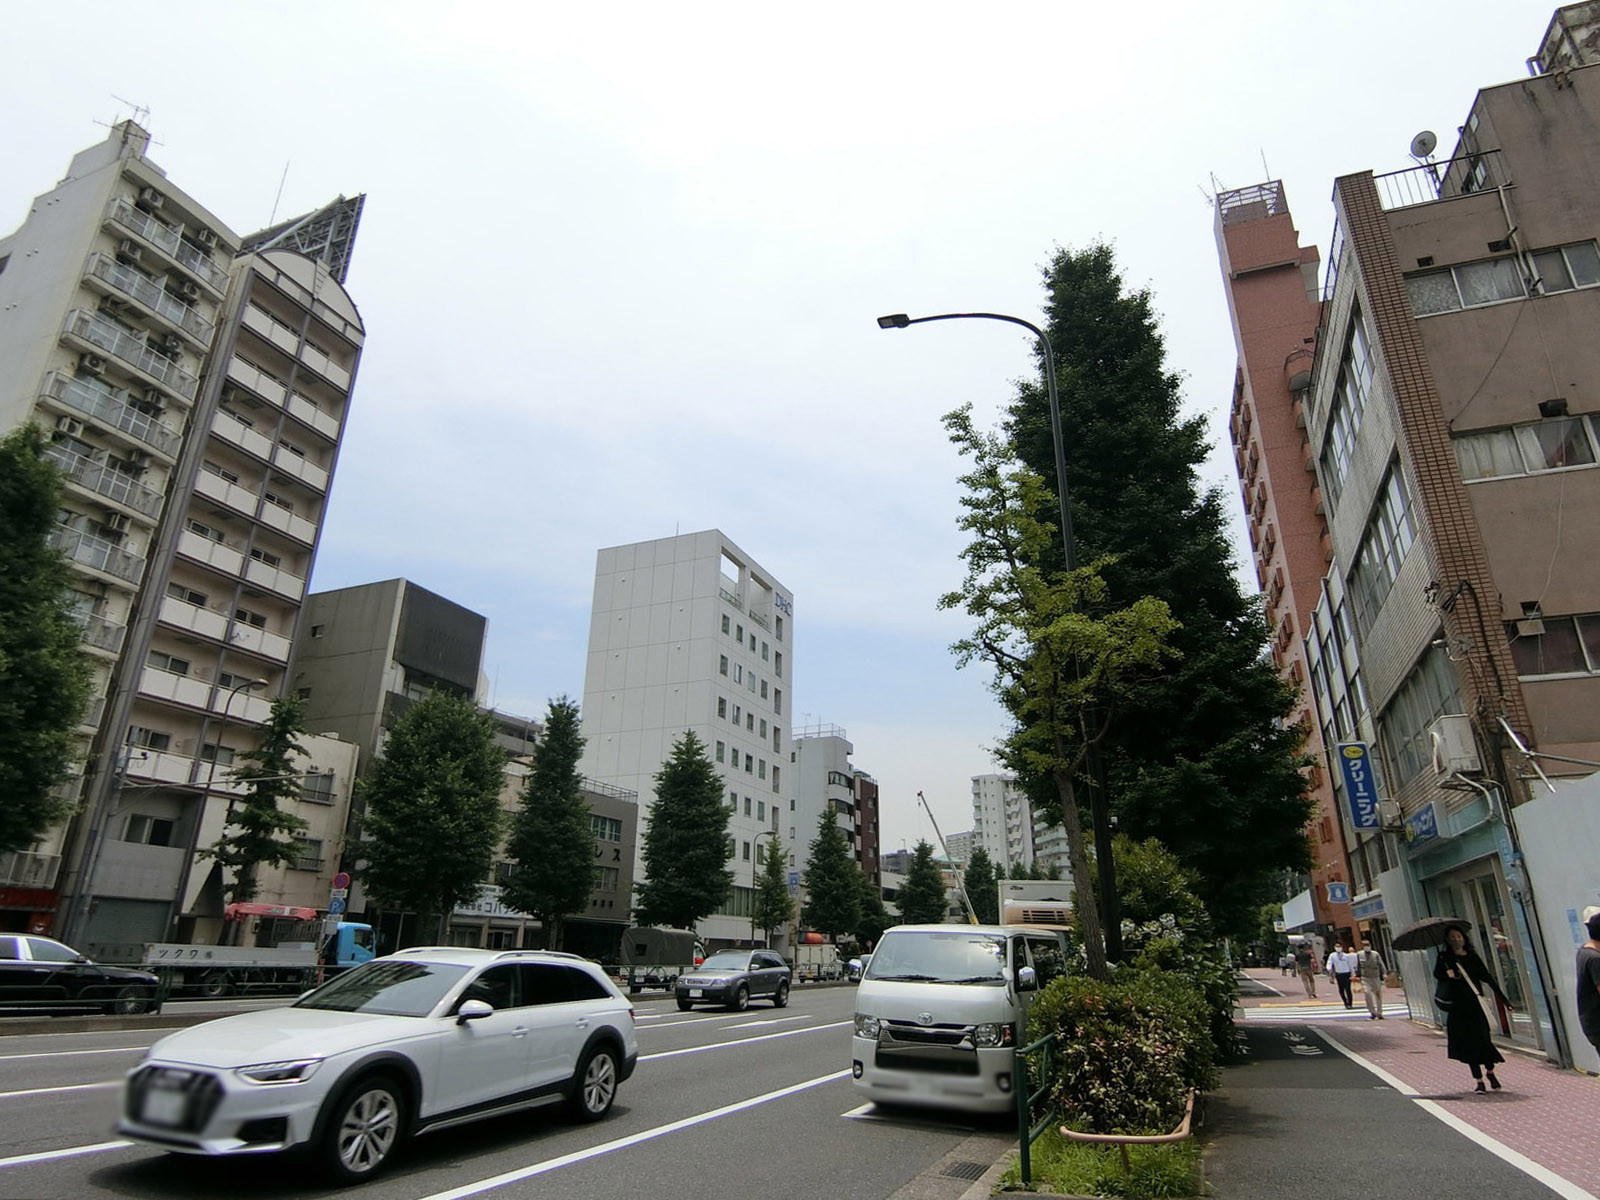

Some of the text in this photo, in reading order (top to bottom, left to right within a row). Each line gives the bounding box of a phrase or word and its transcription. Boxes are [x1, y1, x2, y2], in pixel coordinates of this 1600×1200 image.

[1349, 759, 1376, 826] クリーニング
